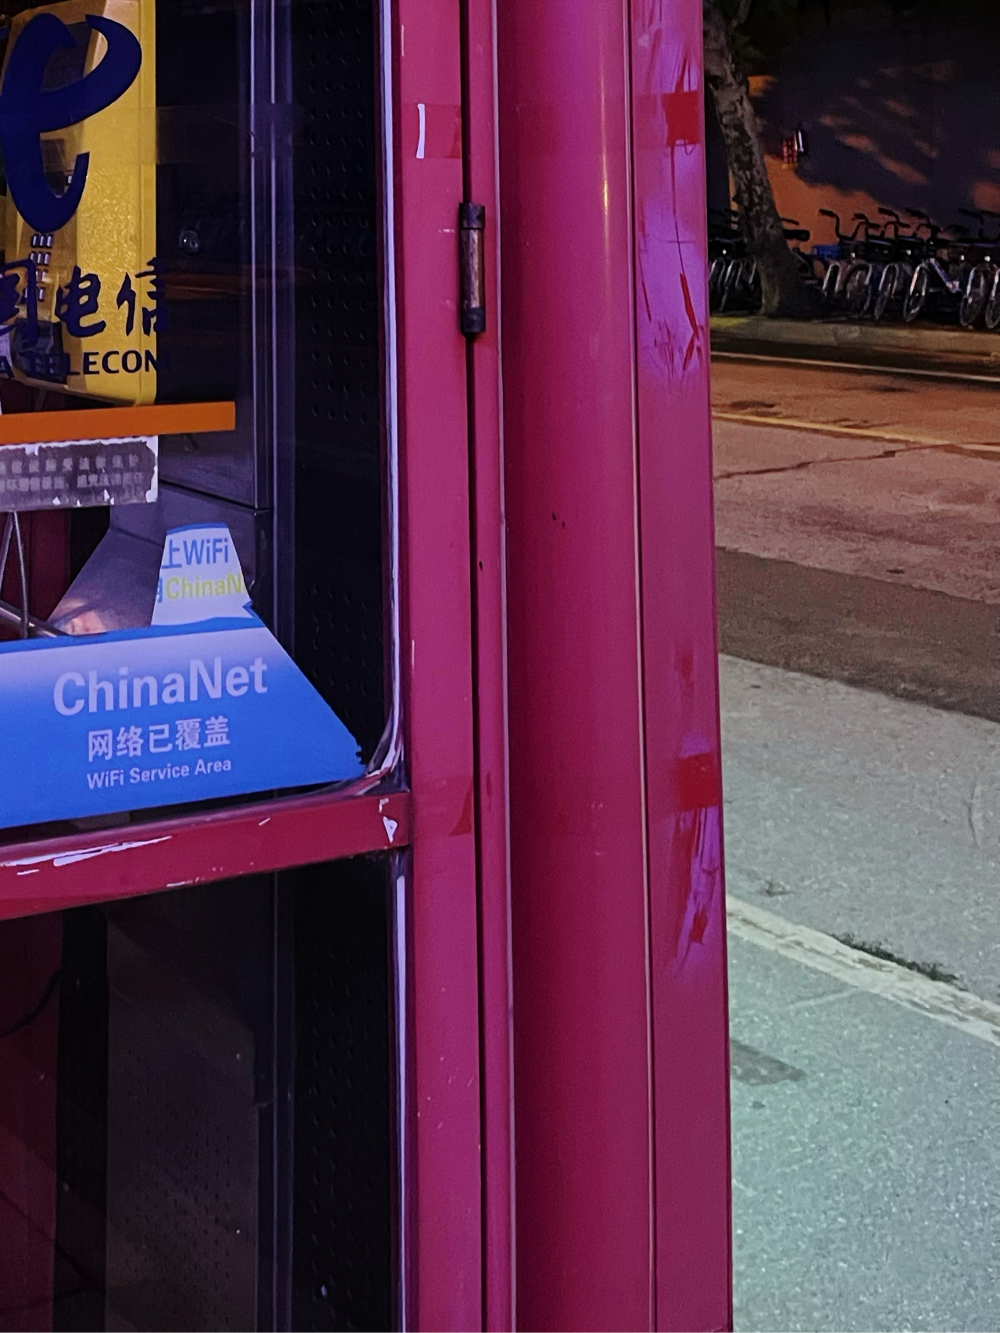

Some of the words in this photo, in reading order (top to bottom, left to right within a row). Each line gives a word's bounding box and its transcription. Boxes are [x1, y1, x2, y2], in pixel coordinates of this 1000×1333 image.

[166, 573, 246, 600] ChinaN
[53, 657, 268, 716] ChinaNet
[88, 716, 230, 762] 网络已覆盖
[87, 770, 124, 790] WiFi
[129, 763, 190, 784] Service
[194, 759, 232, 775] Area
